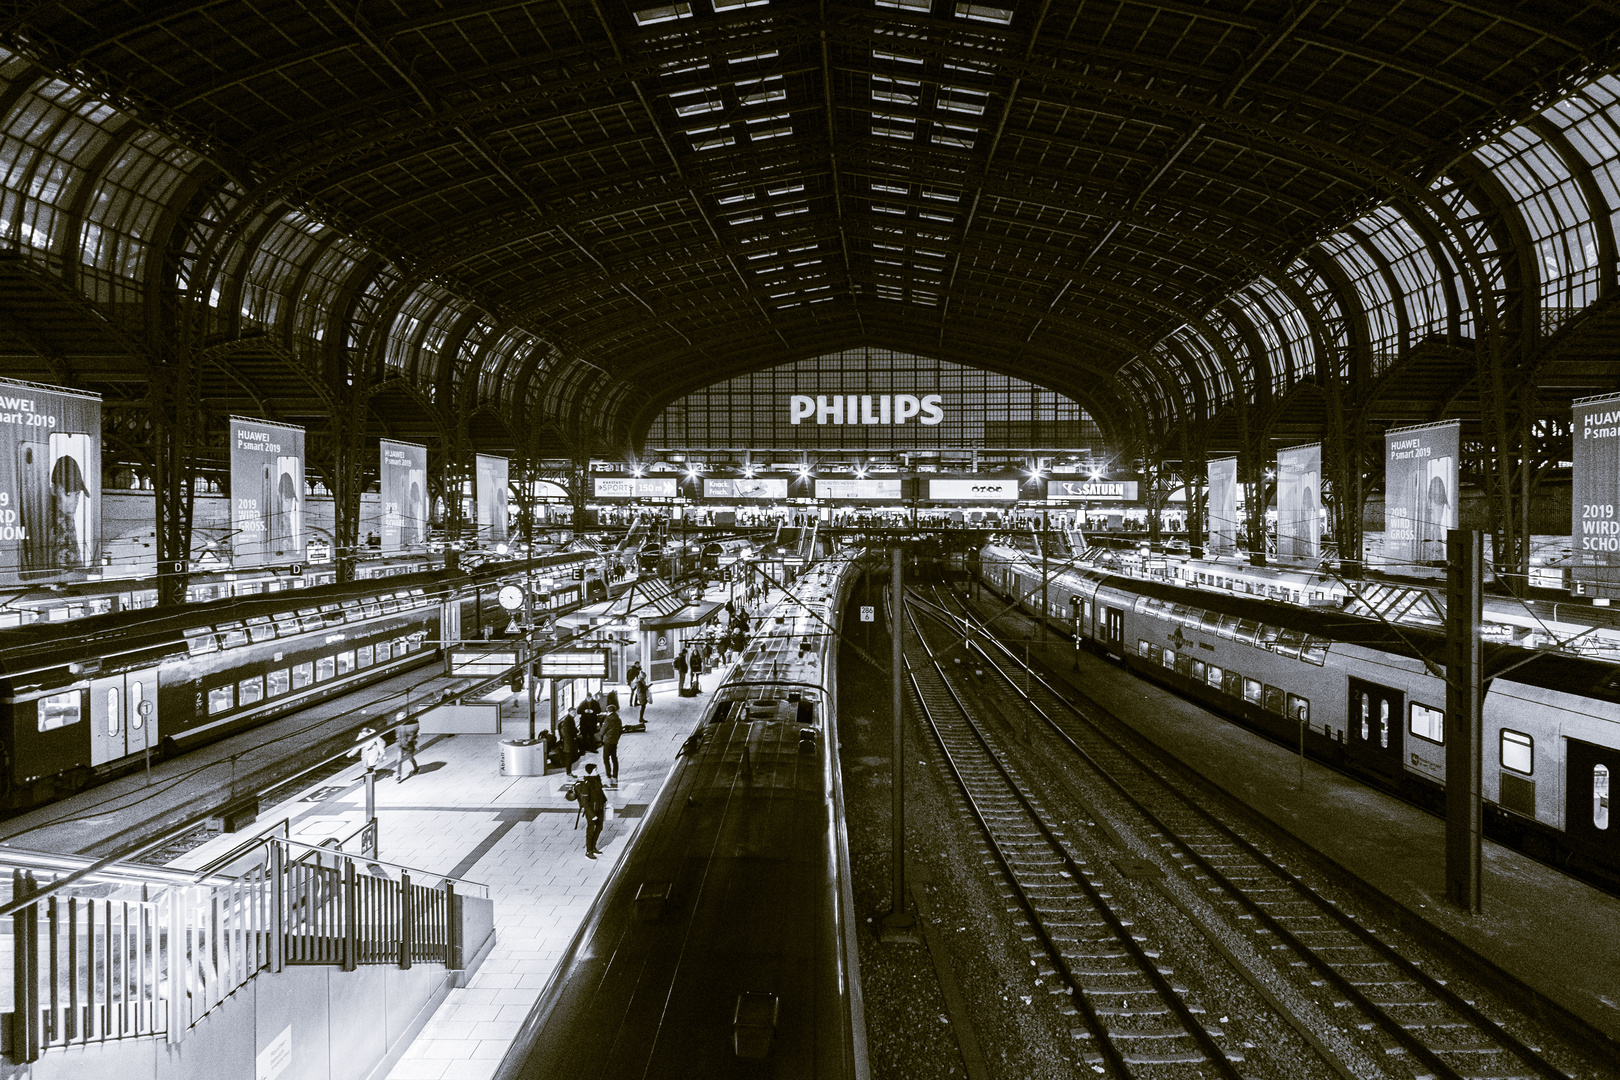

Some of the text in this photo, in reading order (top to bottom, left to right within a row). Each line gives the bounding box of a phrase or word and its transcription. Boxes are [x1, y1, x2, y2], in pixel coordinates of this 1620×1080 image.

[790, 395, 944, 425] PHILIPS
[26, 413, 56, 428] 2019
[237, 430, 270, 443] HUAWEI
[243, 442, 264, 452] smart
[265, 443, 281, 453] 2019
[1391, 439, 1420, 450] HUAWEI
[1396, 450, 1414, 459] smart
[1415, 447, 1431, 457] 2019
[638, 483, 654, 492] 150
[1082, 484, 1124, 495] SATURN
[238, 498, 257, 510] 2019
[238, 509, 261, 520] WIRD
[1391, 507, 1407, 518] 2019
[1582, 504, 1614, 518] 2019
[1390, 519, 1410, 529] WIRD
[1582, 520, 1620, 535] WIRD
[174, 563, 182, 572] D
[293, 564, 300, 574] D
[573, 569, 580, 580] E
[723, 571, 730, 581] E
[1577, 584, 1585, 595] E
[862, 606, 873, 614] 286
[196, 692, 202, 703] 2
